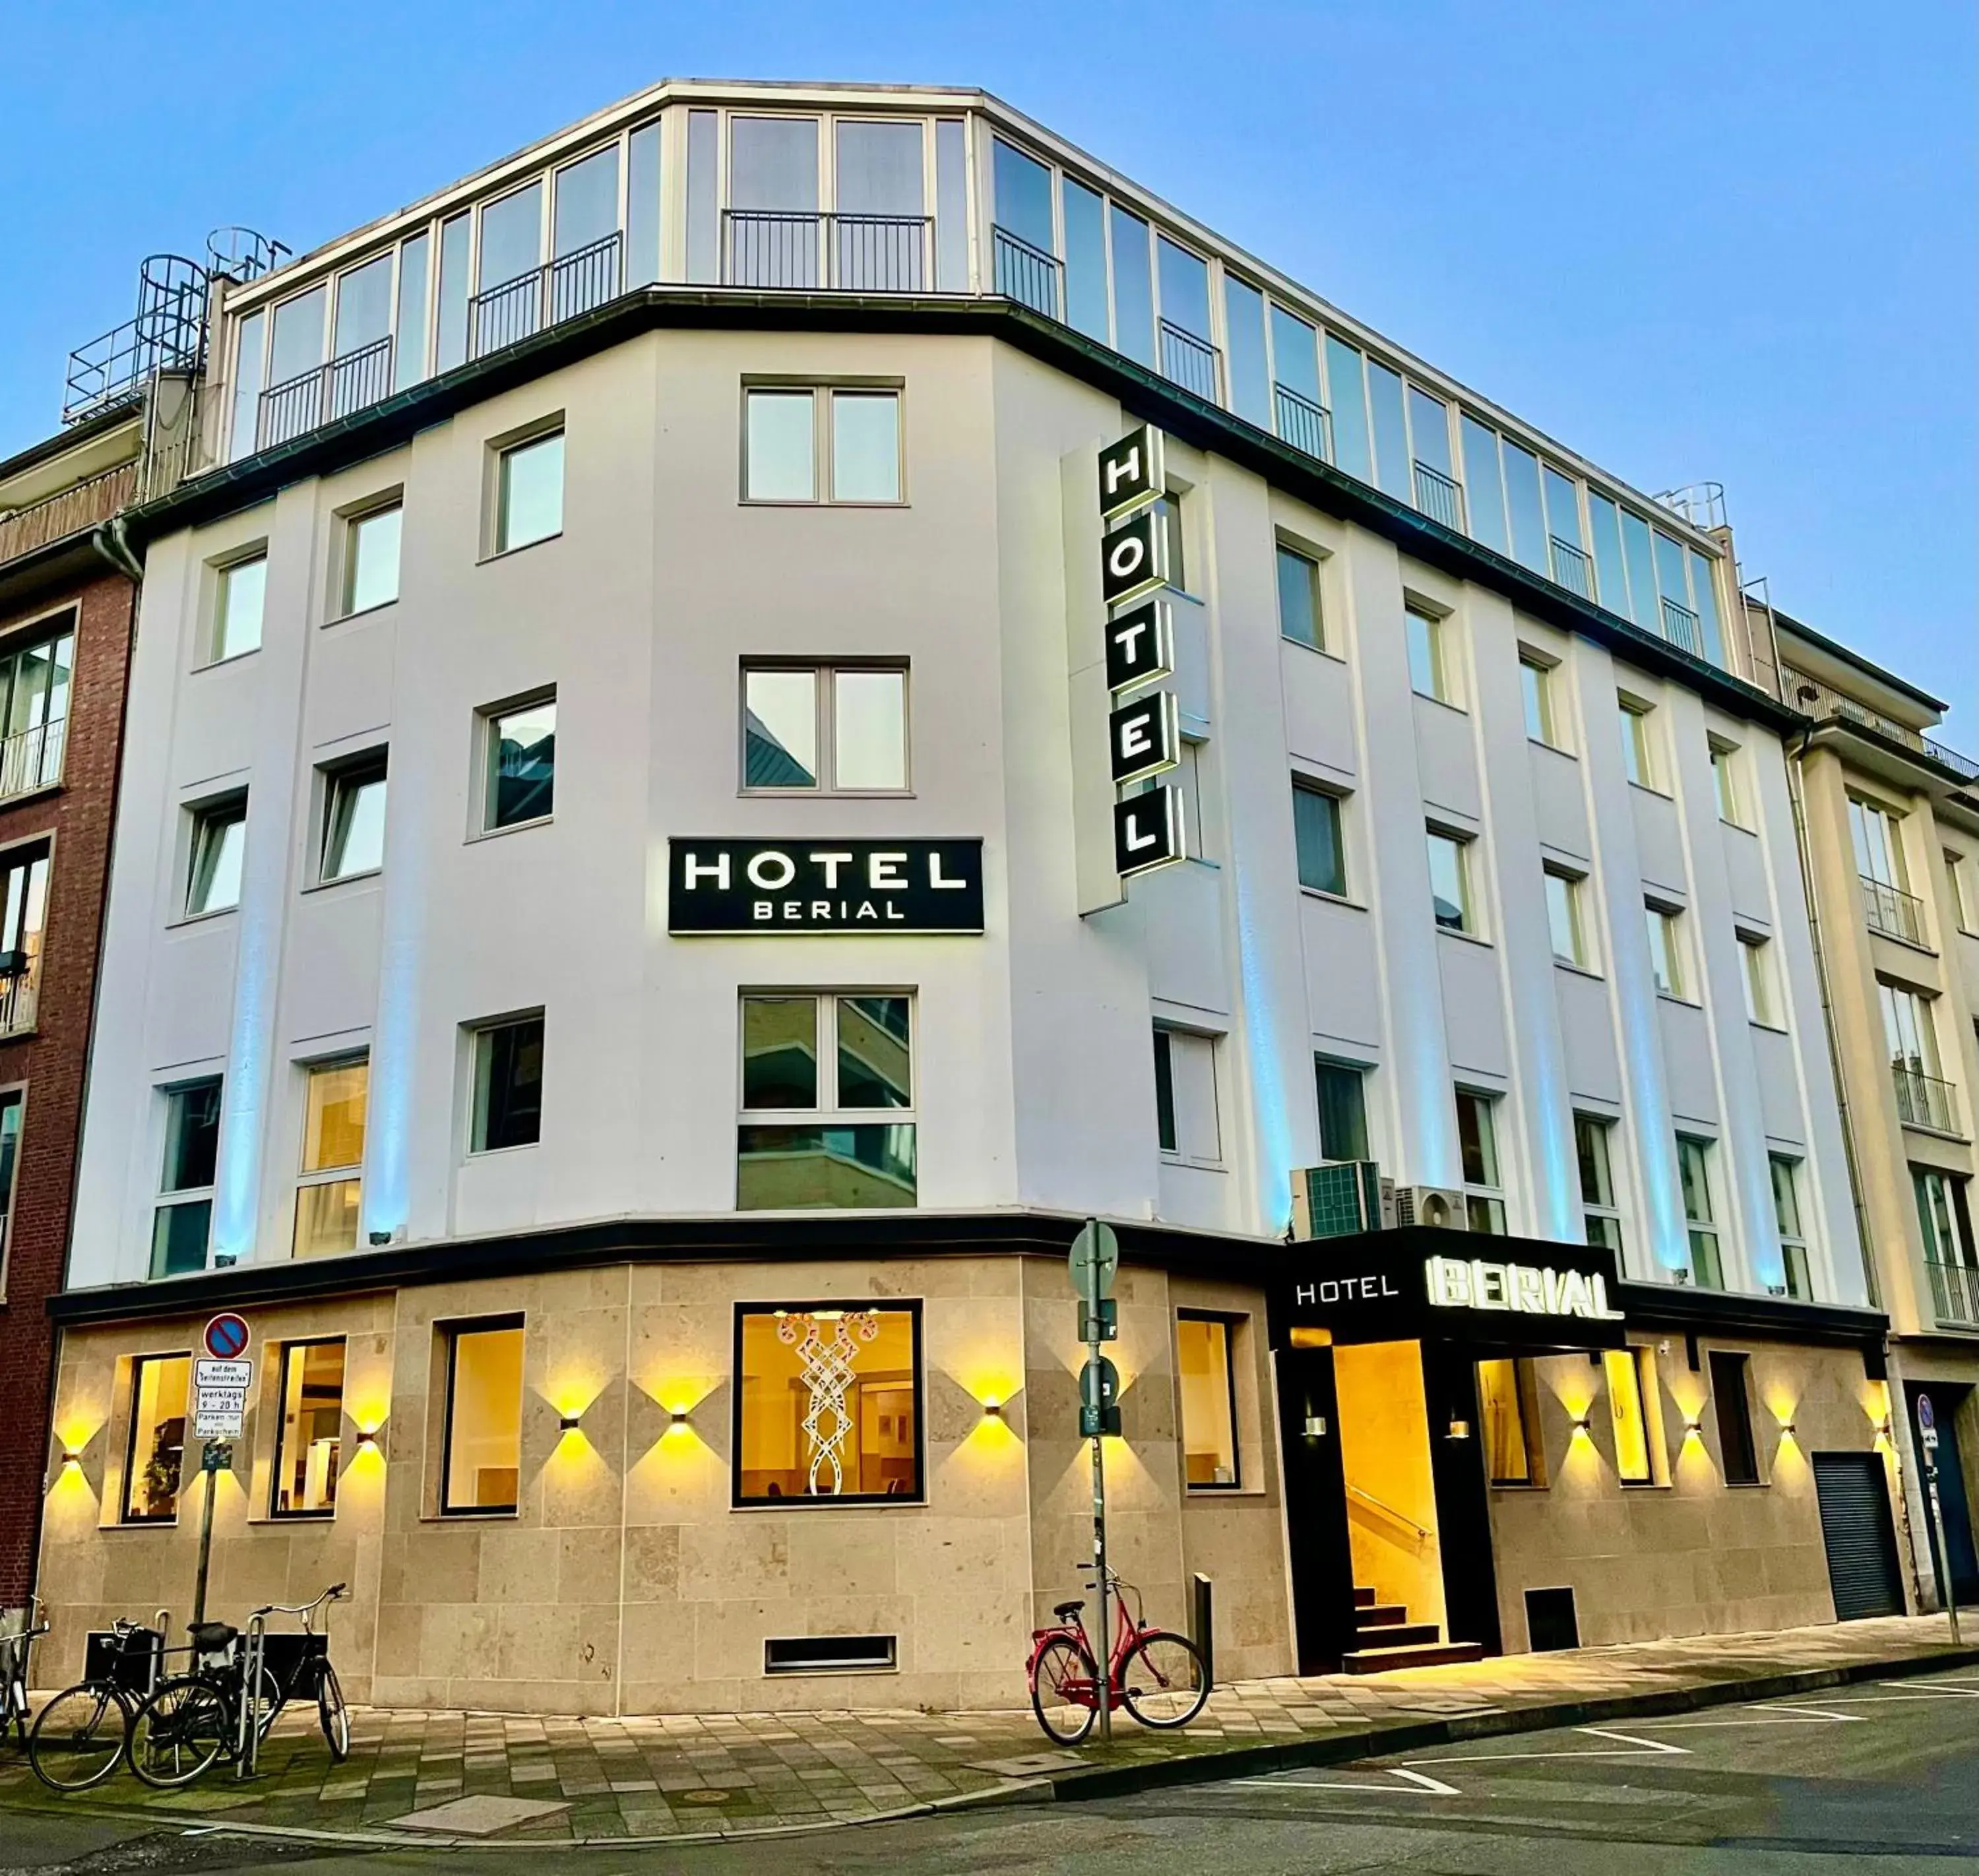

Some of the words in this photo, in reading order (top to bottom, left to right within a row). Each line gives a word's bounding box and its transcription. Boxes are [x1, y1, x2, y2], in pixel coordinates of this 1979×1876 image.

[1107, 446, 1156, 851] HOTEL
[685, 851, 966, 890] HOTEL
[753, 900, 904, 920] BERIAL
[1296, 1274, 1399, 1305] HOTEL
[1426, 1255, 1625, 1320] BERIAL
[201, 1391, 242, 1400] werktags
[220, 1400, 230, 1409] 20
